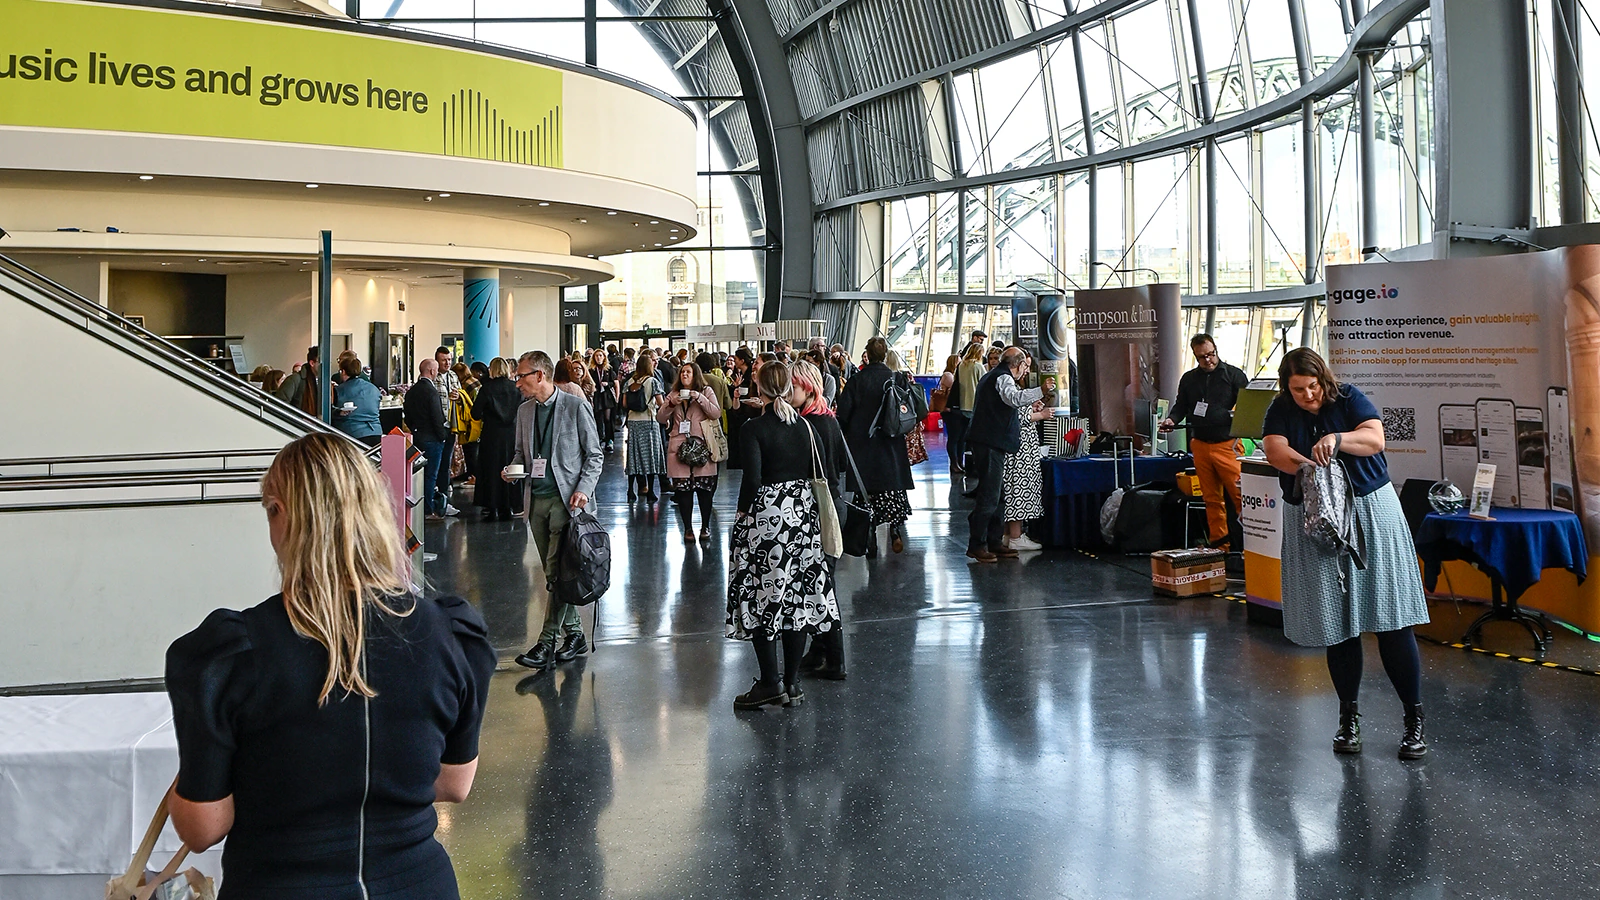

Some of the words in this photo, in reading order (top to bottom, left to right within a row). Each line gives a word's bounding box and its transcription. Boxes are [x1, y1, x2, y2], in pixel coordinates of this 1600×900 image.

[0, 48, 78, 83] usic
[88, 51, 177, 90] lives
[184, 65, 253, 97] and
[259, 73, 360, 107] grows
[366, 79, 429, 114] here
[564, 309, 579, 317] Exit
[1131, 304, 1138, 323] &
[1364, 316, 1383, 326] the
[1385, 315, 1448, 328] experience,
[1449, 314, 1472, 327] gain
[1474, 313, 1511, 324] valuable
[1348, 329, 1405, 340] attraction
[1408, 330, 1454, 339] revenue.
[1335, 347, 1379, 355] all-in-one,
[1381, 347, 1404, 355] cloud
[1432, 346, 1469, 354] attraction
[1471, 347, 1515, 356] management
[1391, 358, 1407, 366] app
[1460, 356, 1474, 364] and
[1476, 356, 1502, 366] heritage
[1172, 574, 1200, 585] FRAGILE
